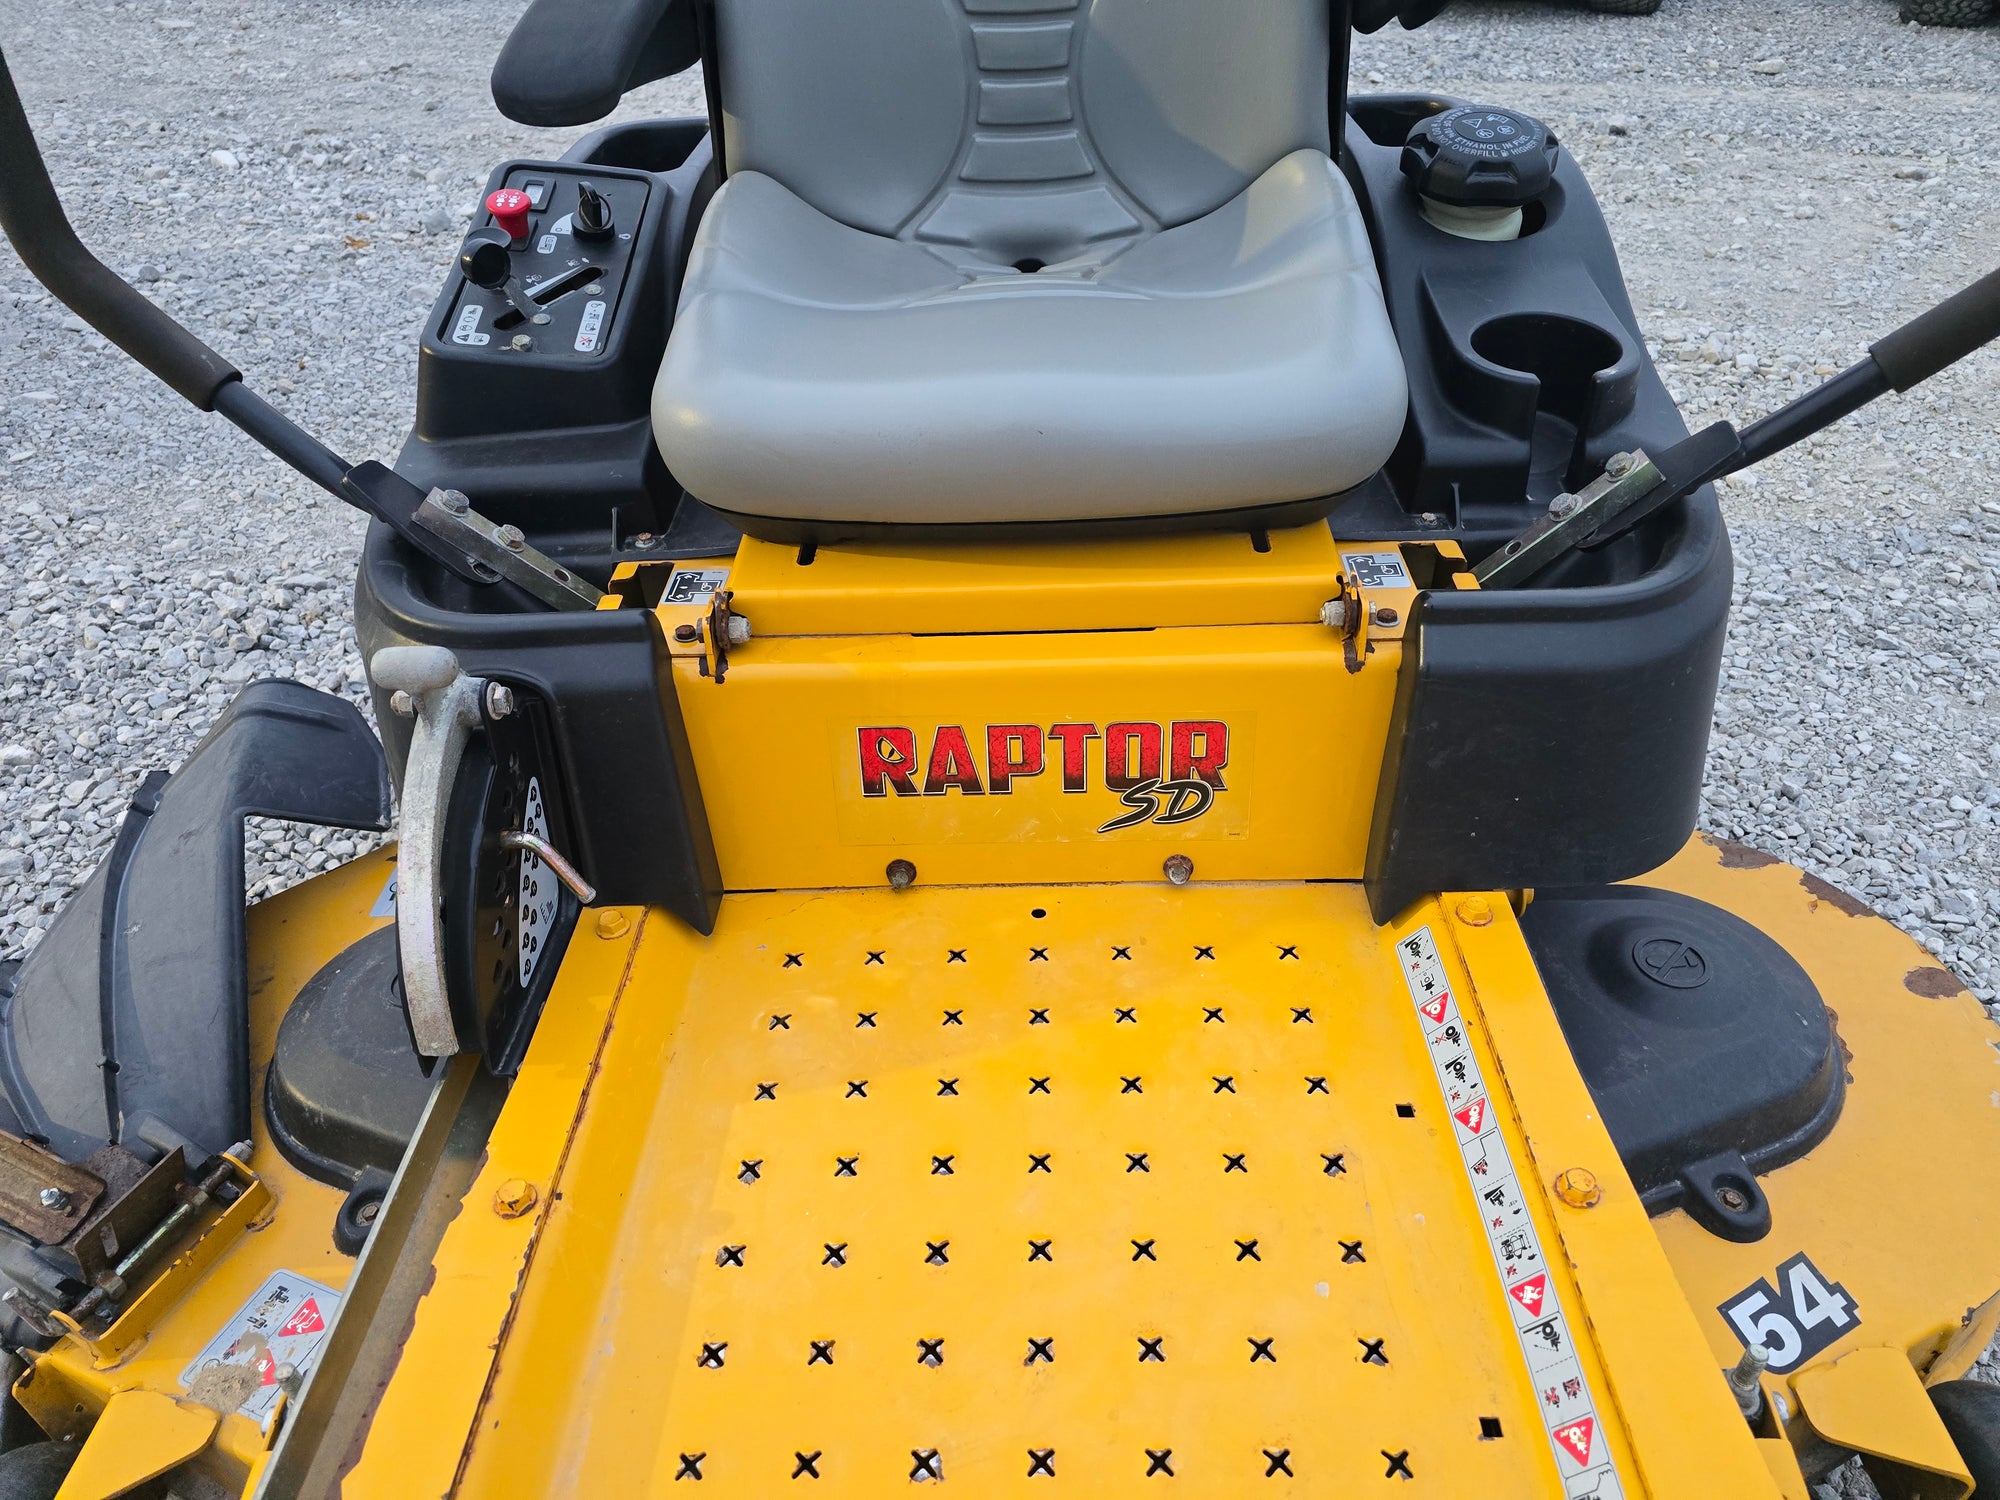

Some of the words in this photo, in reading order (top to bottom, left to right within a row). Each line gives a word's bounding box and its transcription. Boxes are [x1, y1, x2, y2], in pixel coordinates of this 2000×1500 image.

[1451, 144, 1498, 157] OVERFILL
[1510, 140, 1539, 155] HIGHER
[1455, 138, 1500, 150] ETHANOL
[1512, 135, 1531, 147] FUEL
[856, 720, 1230, 796] RAPTOR
[1097, 778, 1215, 833] SD
[1728, 1262, 1850, 1367] 54
